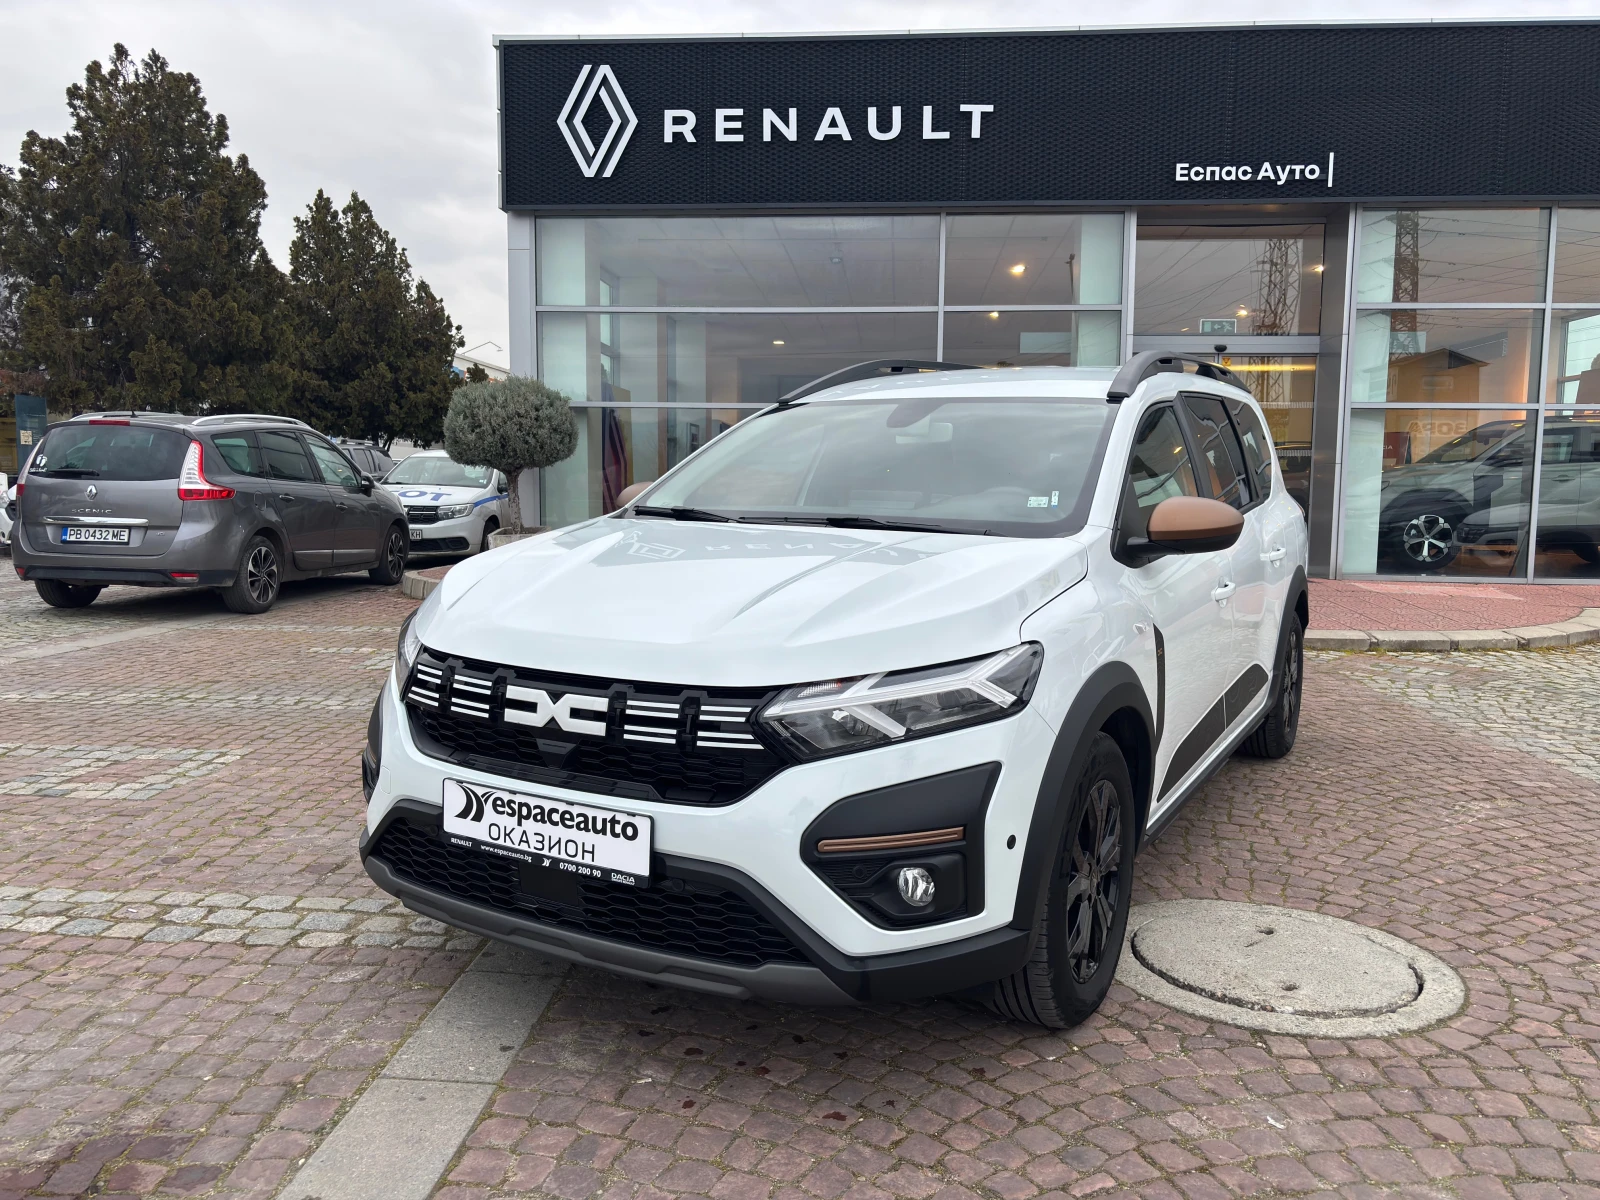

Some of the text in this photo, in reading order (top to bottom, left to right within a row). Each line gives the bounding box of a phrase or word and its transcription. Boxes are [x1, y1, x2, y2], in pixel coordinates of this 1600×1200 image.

[663, 104, 994, 144] RENAULT
[1175, 160, 1321, 187] Еспас Ауто
[68, 528, 82, 540] PB
[84, 529, 110, 541] 0432
[111, 530, 127, 541] ME
[491, 796, 639, 841] espaceauto
[450, 837, 473, 848] RENAULT
[480, 844, 533, 863] www.espaceauto.bg
[559, 861, 577, 873] 0700
[577, 865, 592, 876] 200
[592, 868, 602, 878] 90
[611, 872, 636, 883] DACIA
[488, 822, 596, 863] ОКАЗИОН
